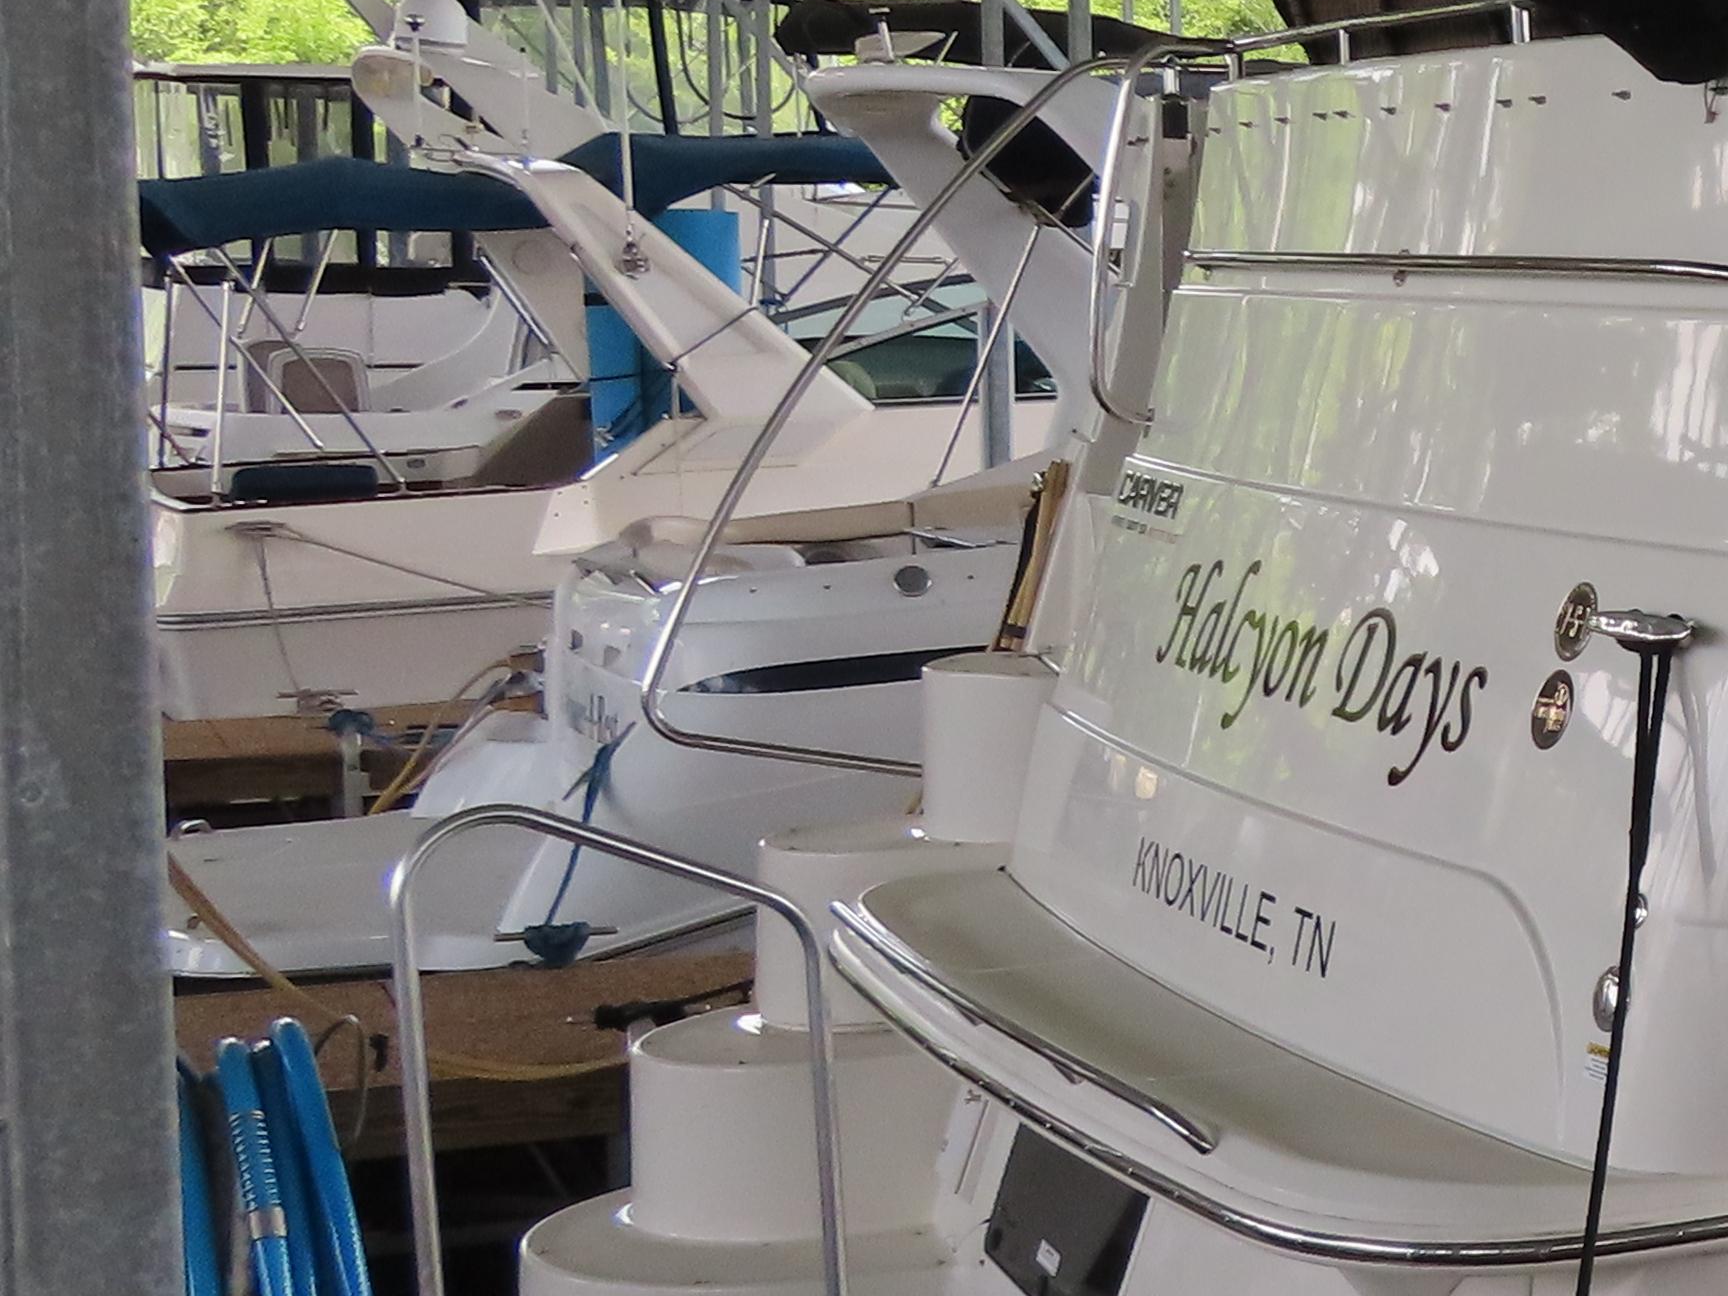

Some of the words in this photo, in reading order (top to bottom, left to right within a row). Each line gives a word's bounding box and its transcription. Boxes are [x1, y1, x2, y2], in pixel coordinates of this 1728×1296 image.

[1155, 559, 1330, 729] Halcyon
[1331, 606, 1488, 786] Days
[1132, 836, 1276, 964] KNOXVILLE,
[1292, 906, 1336, 978] TN
